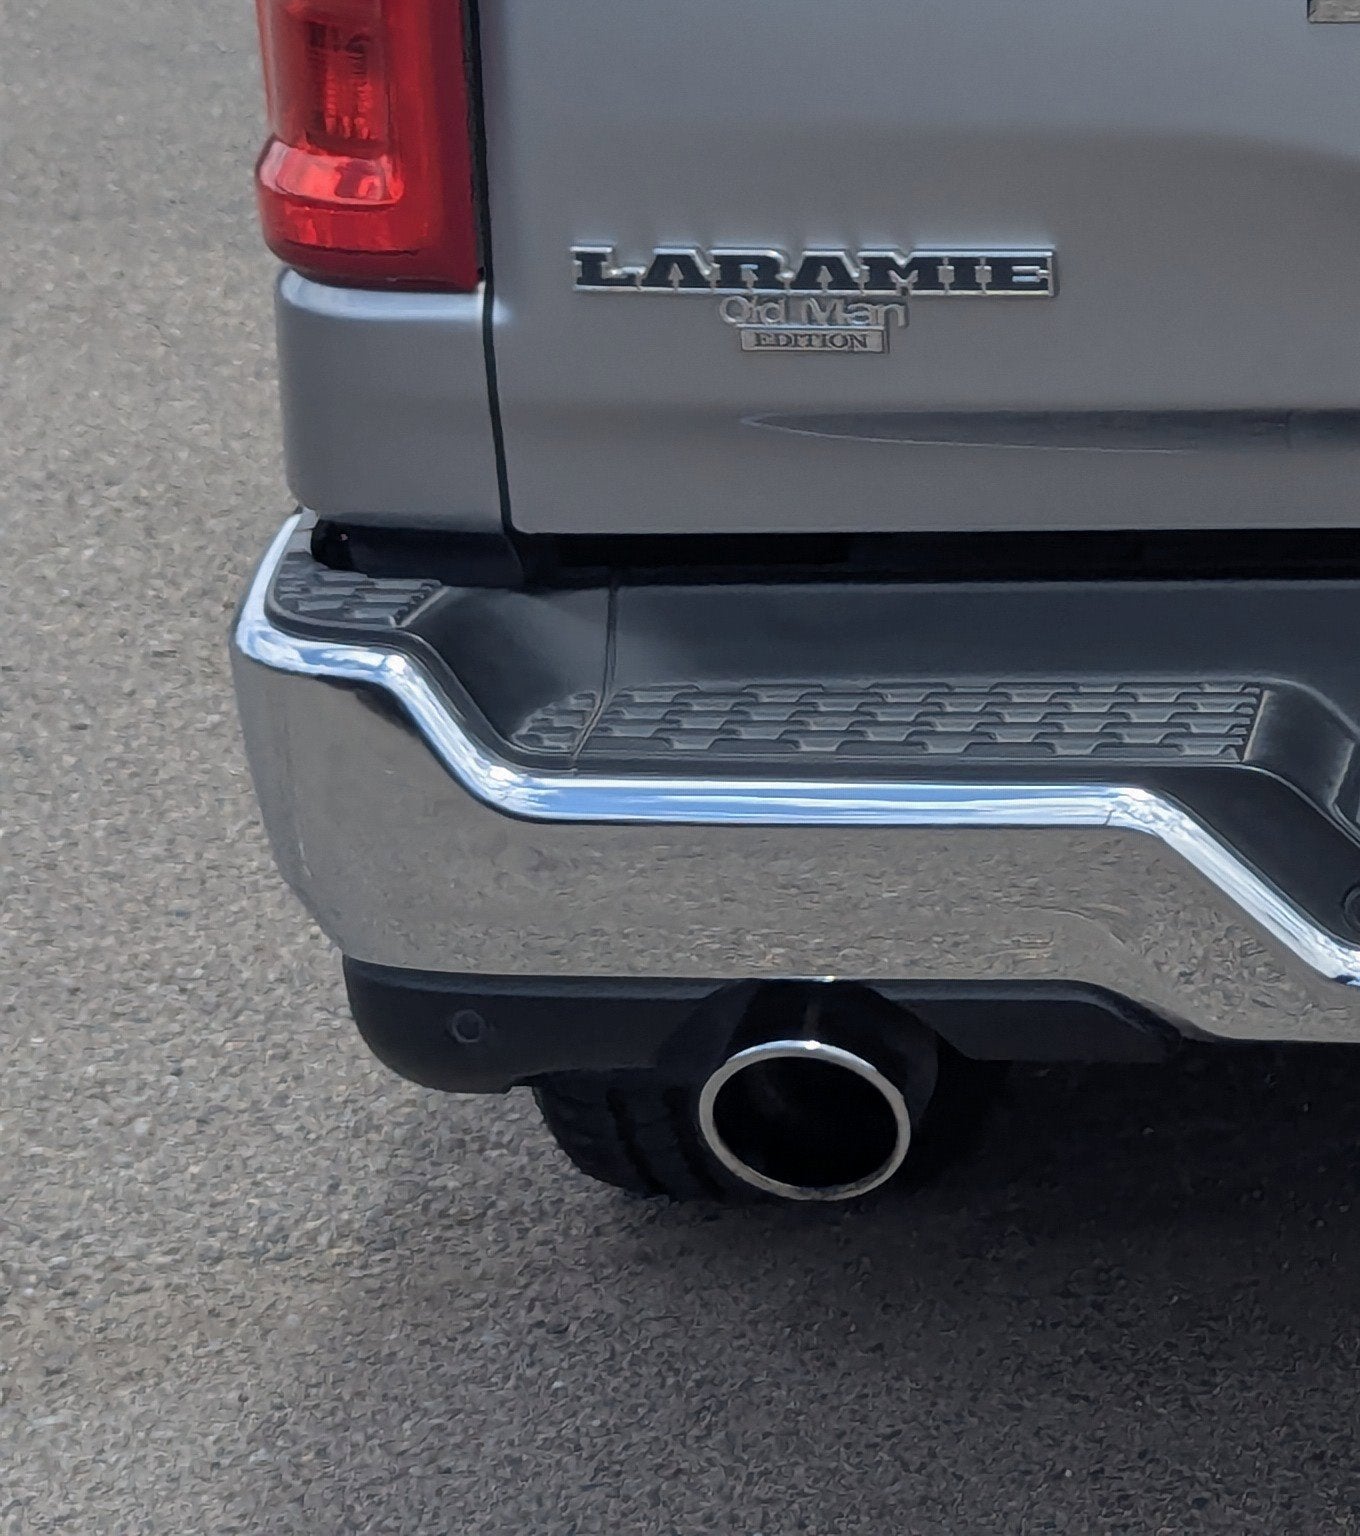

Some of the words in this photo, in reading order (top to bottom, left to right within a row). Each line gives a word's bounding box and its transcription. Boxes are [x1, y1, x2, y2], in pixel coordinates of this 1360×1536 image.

[570, 245, 1058, 296] LARAMIE
[718, 295, 788, 328] Old
[801, 295, 908, 328] Man
[754, 330, 869, 350] EDITION
